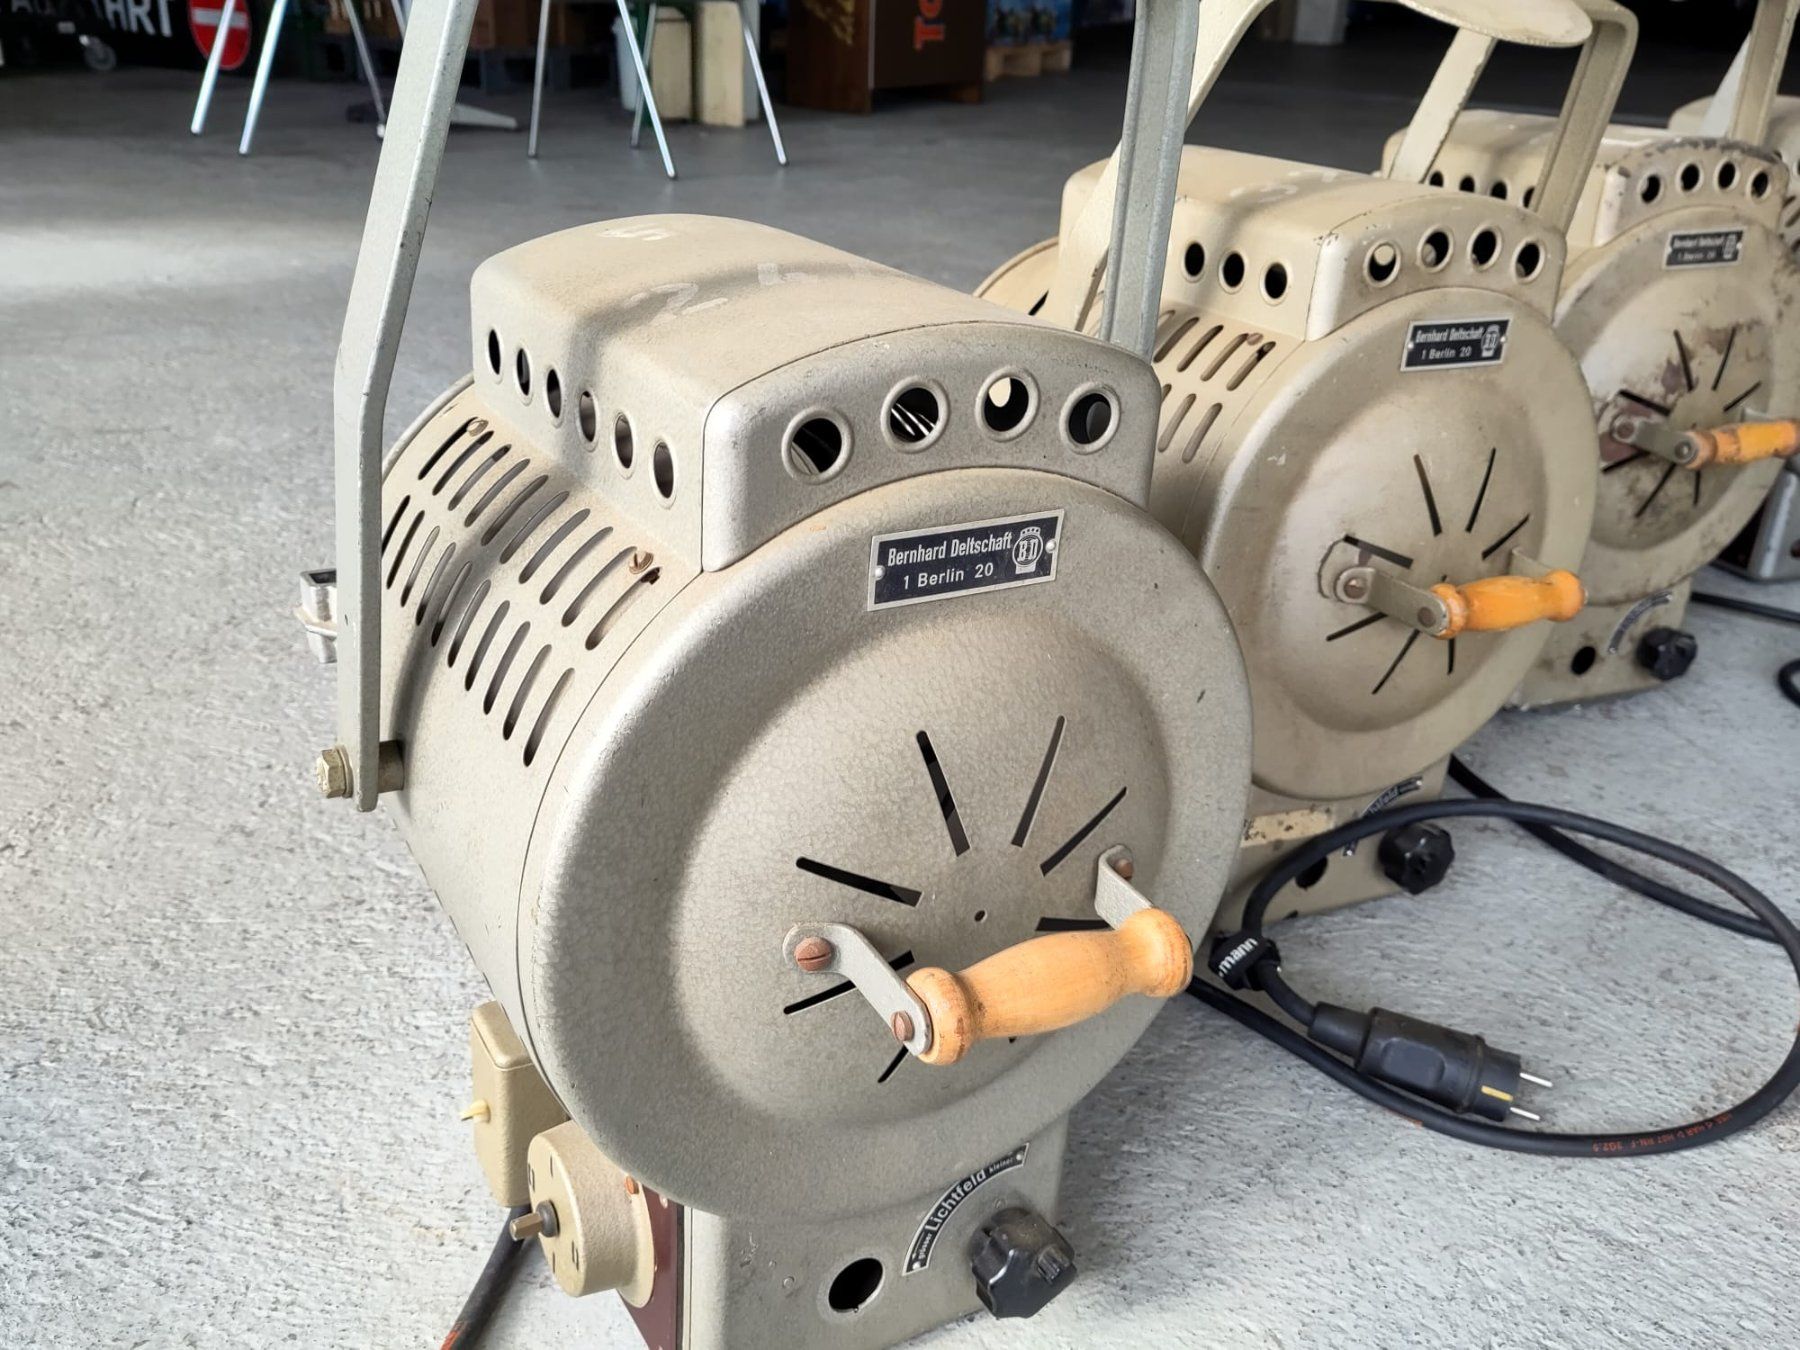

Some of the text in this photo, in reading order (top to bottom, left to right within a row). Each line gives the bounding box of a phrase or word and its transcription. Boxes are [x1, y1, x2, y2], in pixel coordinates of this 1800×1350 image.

[1429, 347, 1456, 359] Berlin
[1460, 346, 1473, 358] 20
[887, 531, 1013, 567] Bernhard Deltschaft
[903, 562, 994, 590] 1 Berlin 20
[1218, 937, 1259, 978] mann
[924, 1168, 987, 1233] Lichtfeld
